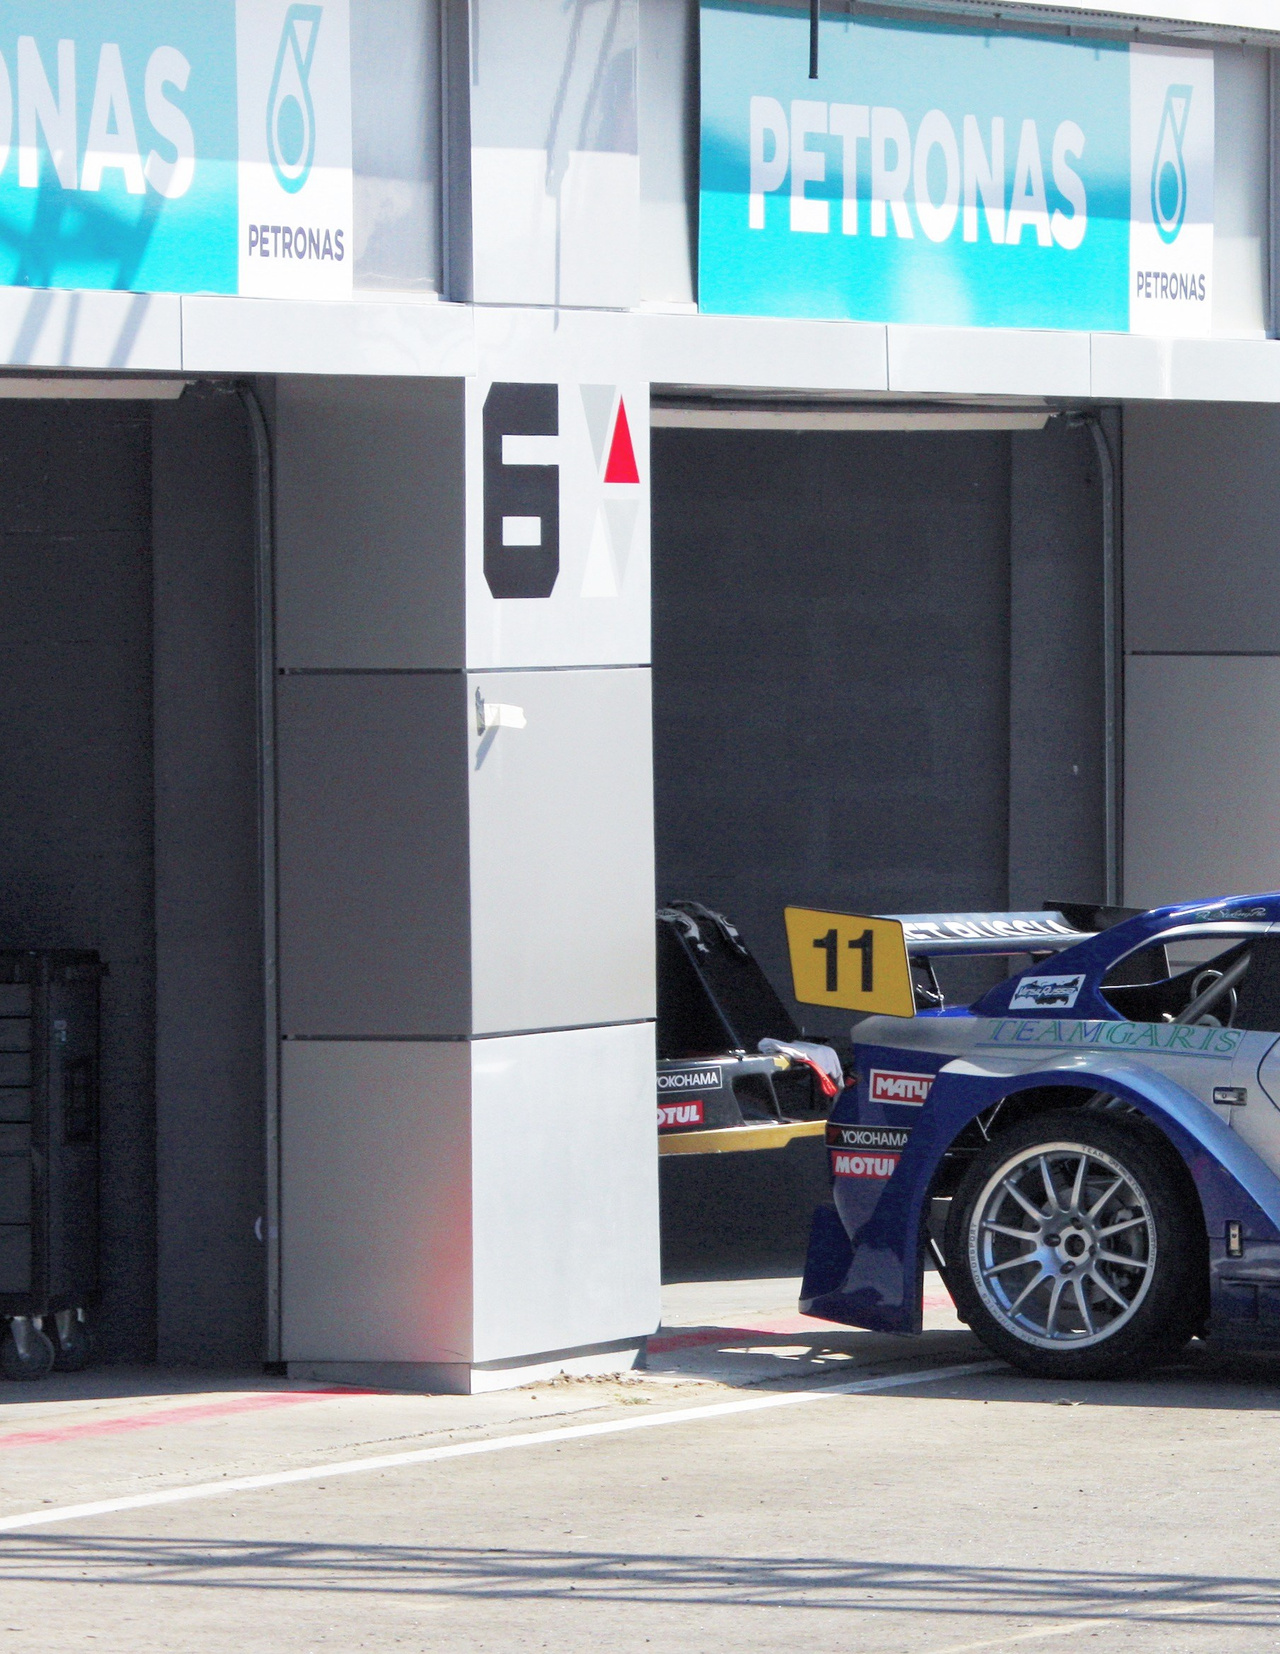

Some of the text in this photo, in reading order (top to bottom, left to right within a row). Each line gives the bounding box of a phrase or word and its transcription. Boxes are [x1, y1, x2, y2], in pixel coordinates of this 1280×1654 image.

[0, 35, 195, 199] NAS
[748, 95, 1088, 250] PETRONAS
[248, 224, 345, 261] PETRONAS
[1136, 270, 1206, 301] PETRONAS
[482, 382, 559, 599] 6
[813, 929, 873, 992] 11
[656, 1071, 719, 1088] OKOHAMA
[841, 1130, 908, 1146] YOKOHAMA
